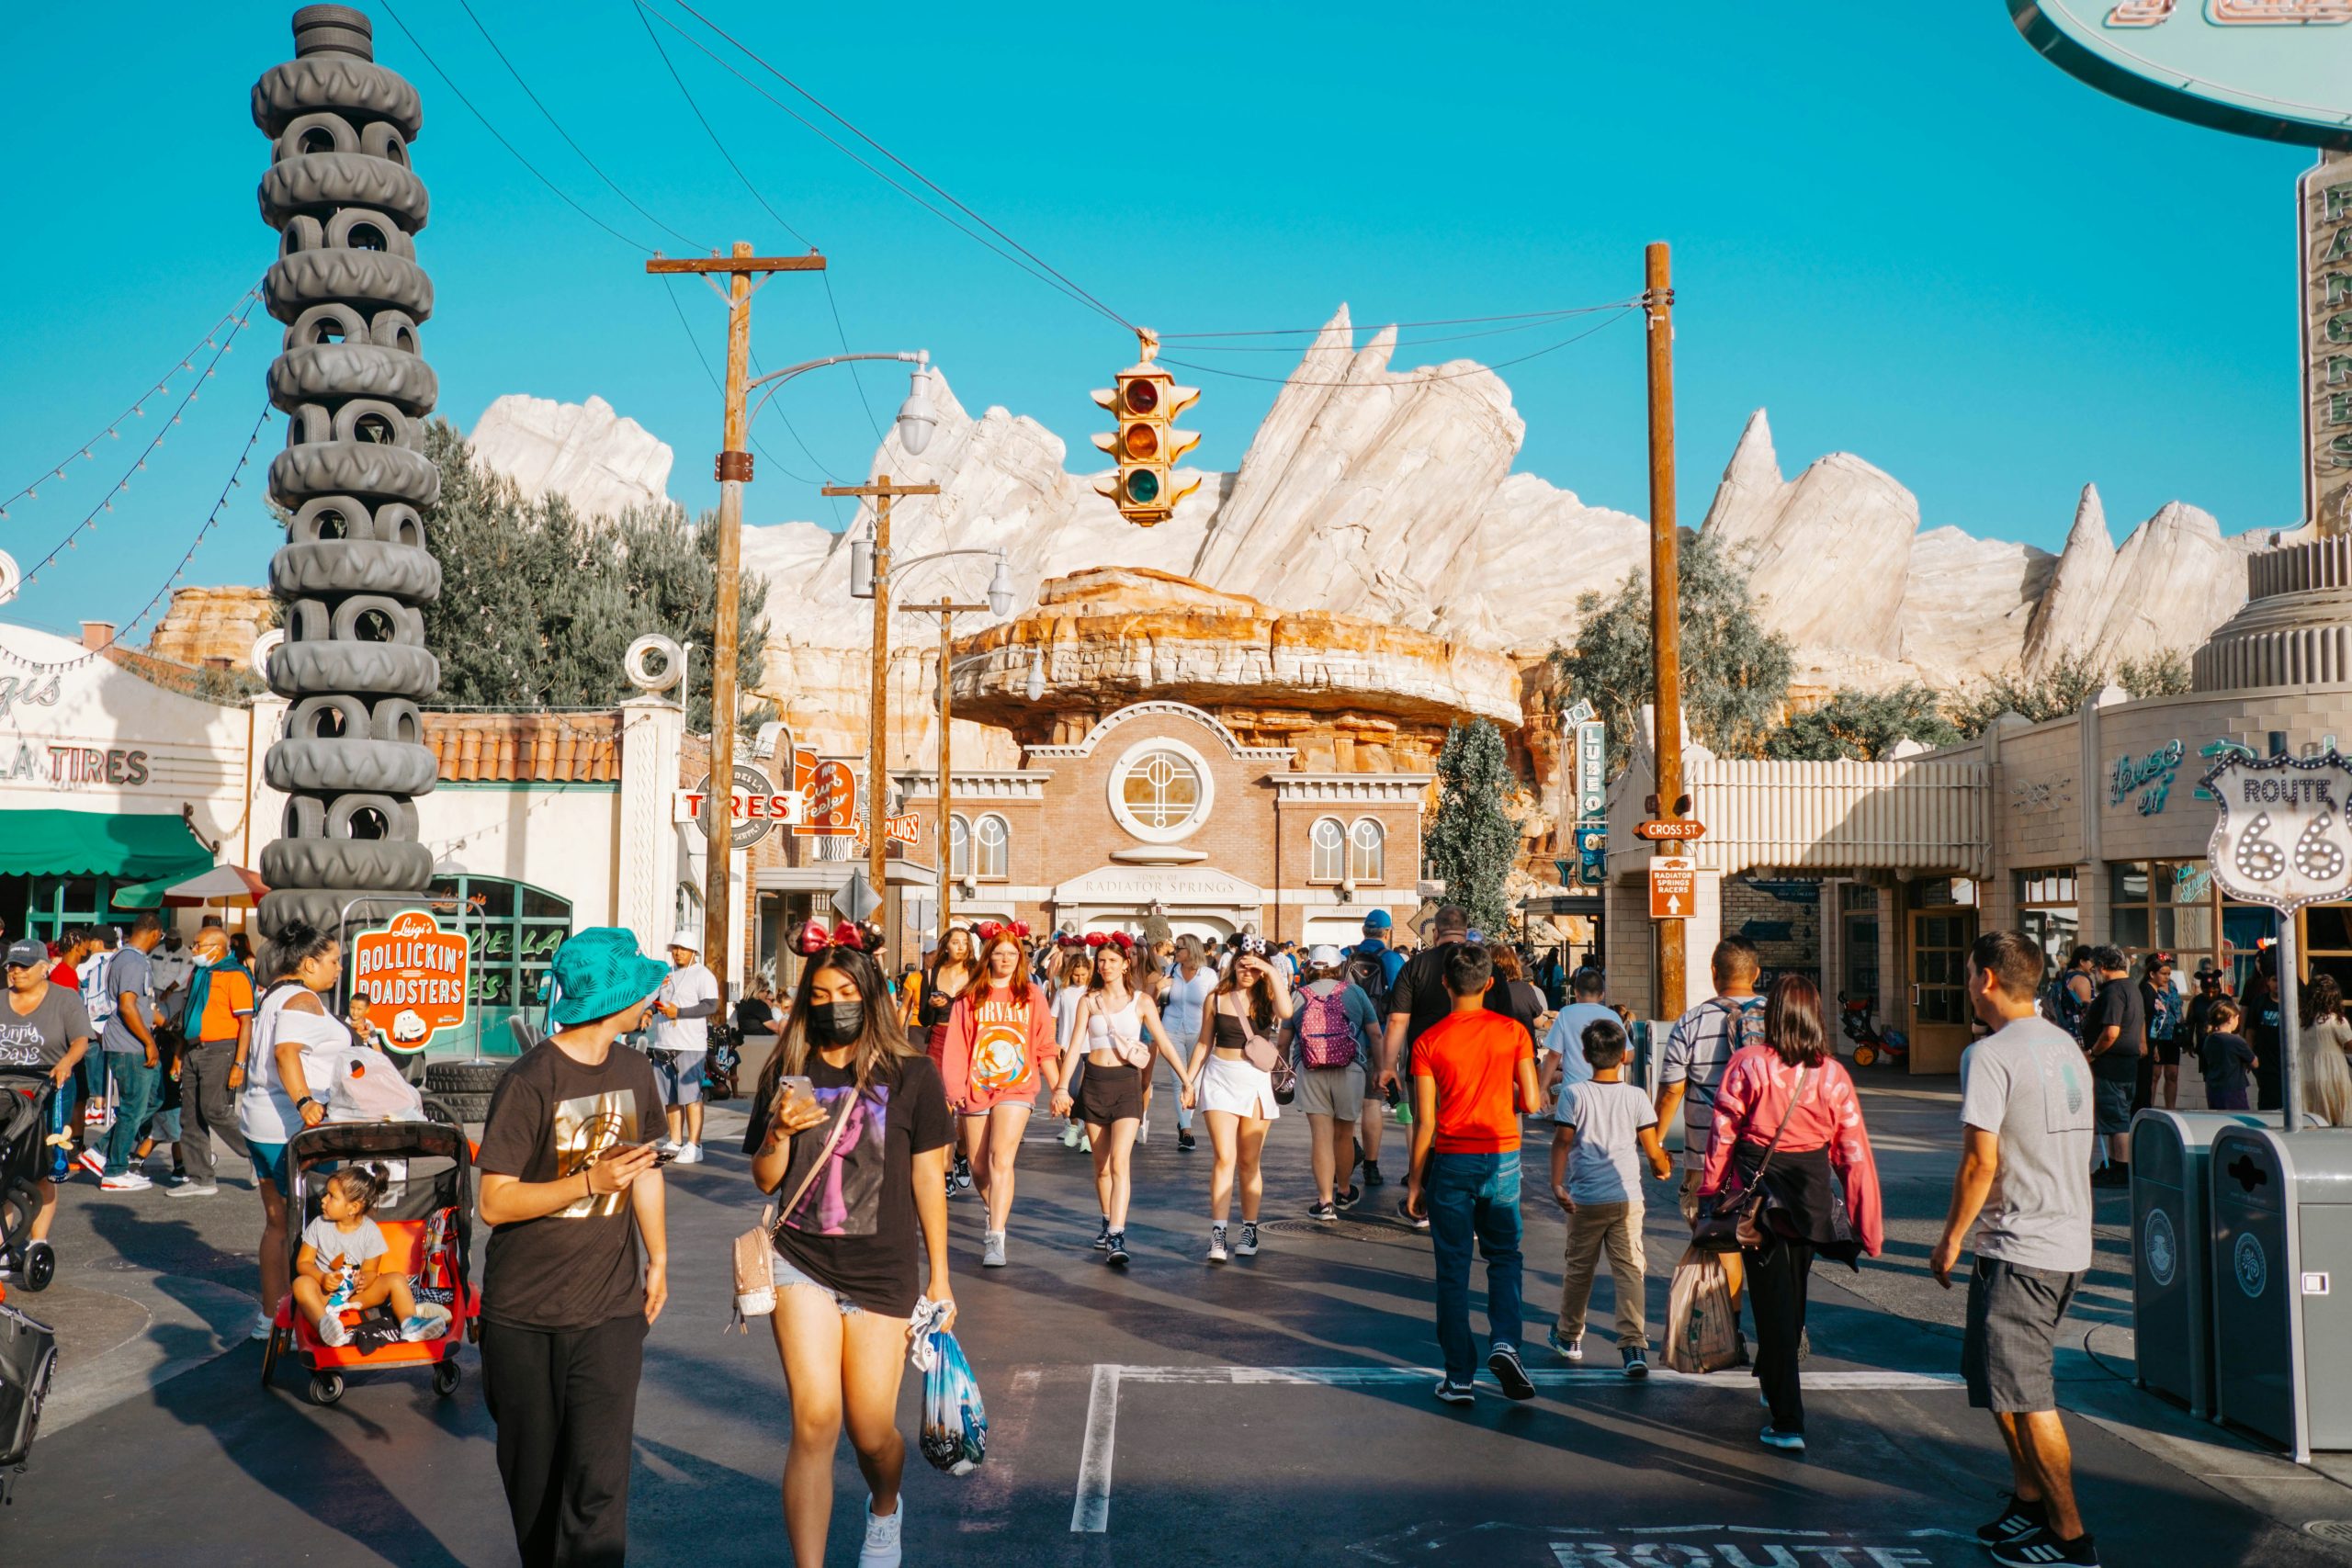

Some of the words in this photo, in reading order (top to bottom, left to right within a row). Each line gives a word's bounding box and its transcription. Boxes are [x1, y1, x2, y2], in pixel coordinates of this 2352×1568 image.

[48, 745, 149, 785] TIRES
[802, 774, 842, 801] Curb
[2245, 779, 2331, 803] ROUTE
[684, 793, 790, 820] TRES
[885, 815, 918, 841] PLUGS
[1649, 824, 1682, 835] CROSS
[1685, 824, 1699, 835] ST.
[2235, 811, 2345, 882] 66
[1086, 882, 1162, 893] RADIATOR
[1170, 882, 1235, 894] SPRINGS
[391, 917, 432, 940] Luigi's
[359, 942, 464, 976] ROLLICKIN'
[357, 978, 461, 1004] ROADSTERS
